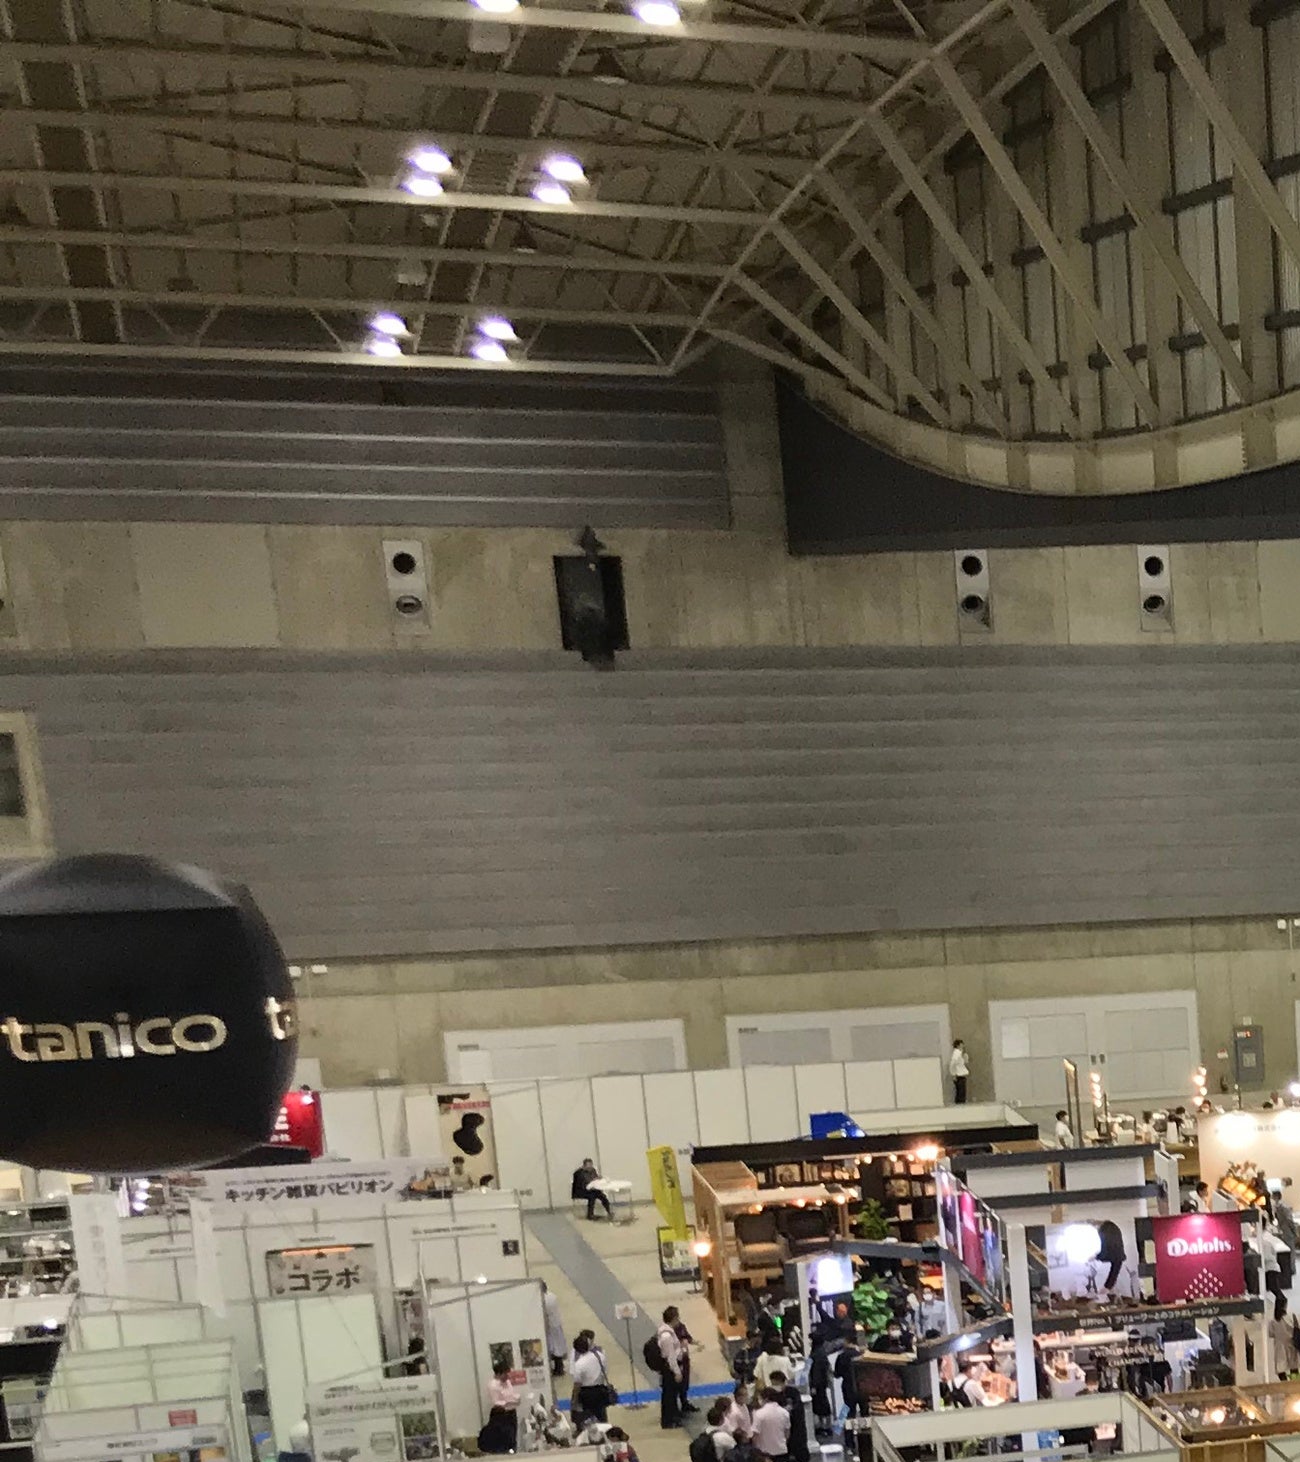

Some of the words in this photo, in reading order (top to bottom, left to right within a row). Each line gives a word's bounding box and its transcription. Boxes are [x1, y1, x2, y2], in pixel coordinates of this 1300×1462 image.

[1, 1014, 227, 1062] tanico
[288, 1266, 361, 1292] コラボ
